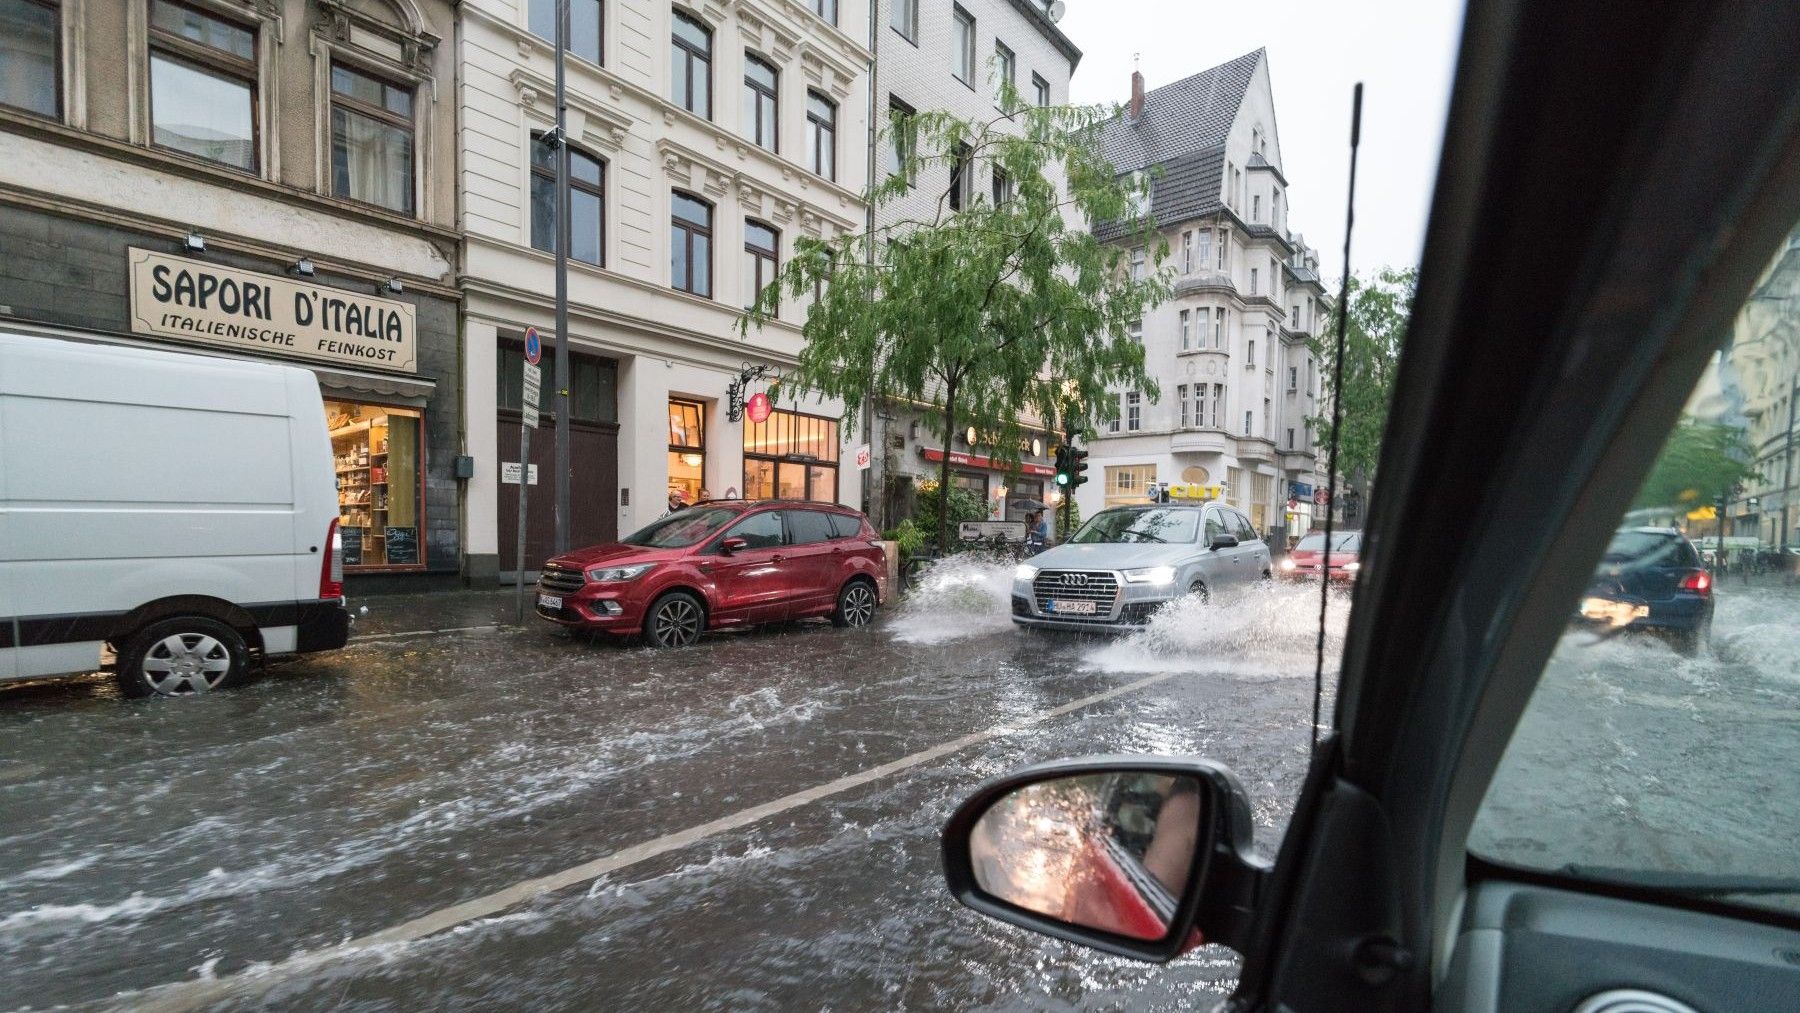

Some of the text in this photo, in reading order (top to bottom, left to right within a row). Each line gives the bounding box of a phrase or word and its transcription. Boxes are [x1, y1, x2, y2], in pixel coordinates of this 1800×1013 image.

[152, 264, 402, 343] SAPORI D'ITALIA
[160, 313, 397, 362] ITALIENISCHE FEINKOST
